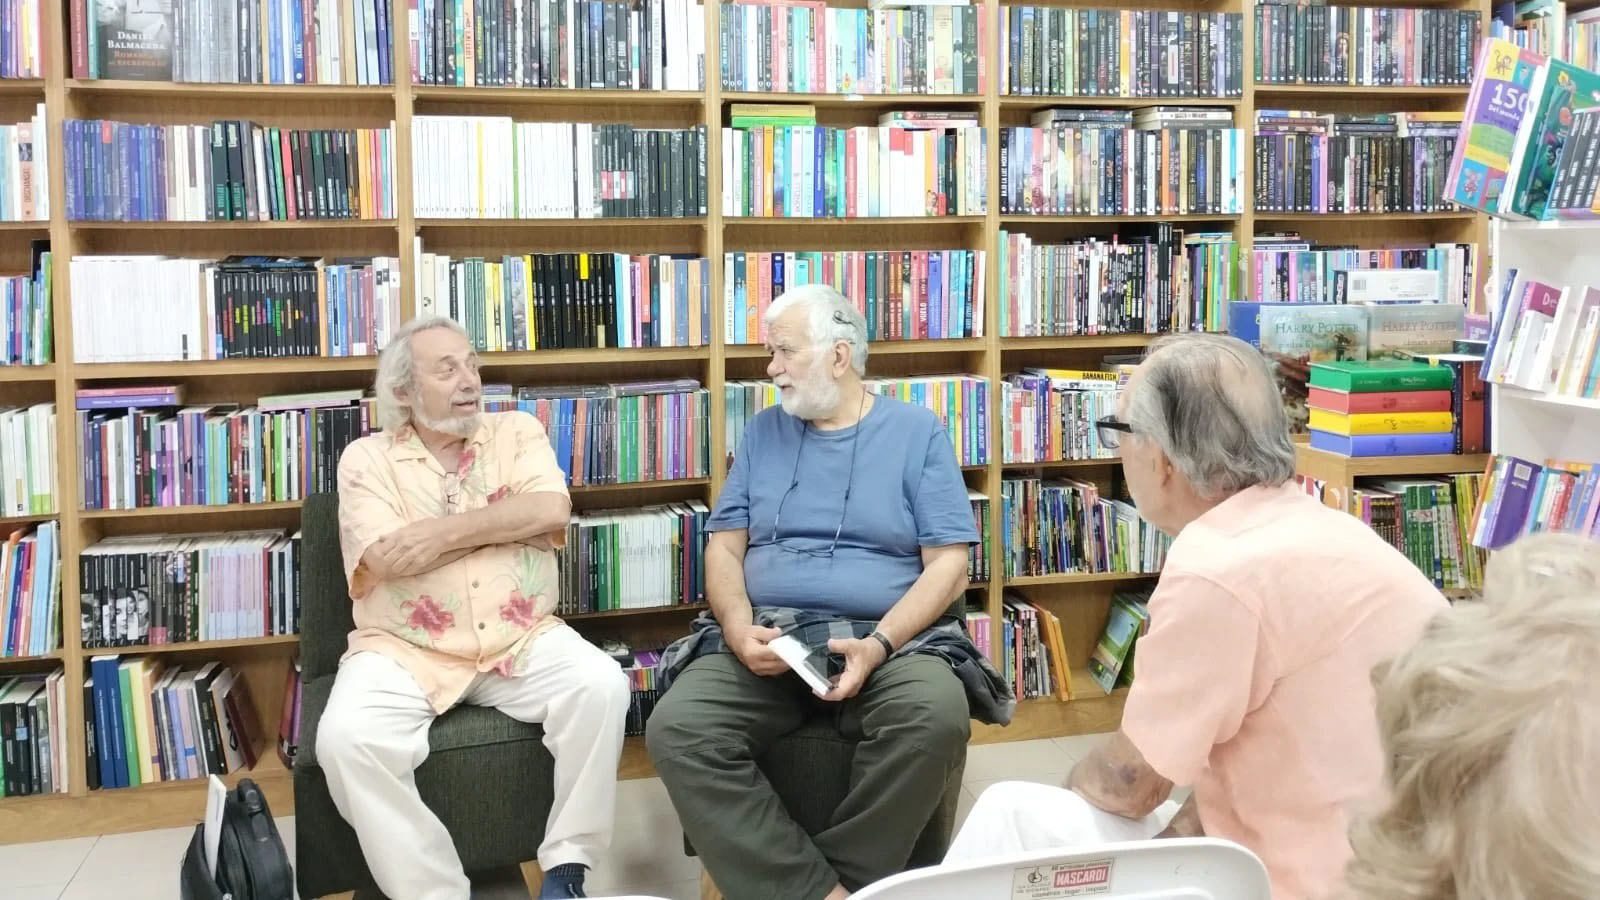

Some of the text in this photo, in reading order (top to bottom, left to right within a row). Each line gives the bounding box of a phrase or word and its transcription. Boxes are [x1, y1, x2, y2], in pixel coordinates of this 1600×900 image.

[117, 31, 153, 40] DANIEL
[107, 40, 165, 49] BALMACEDA
[919, 302, 927, 322] VUELO
[1275, 322, 1360, 334] HARRY POTTER
[1382, 321, 1418, 332] HARRY
[1082, 373, 1117, 382] BANANA FISH
[1056, 868, 1107, 886] MASCARDI
